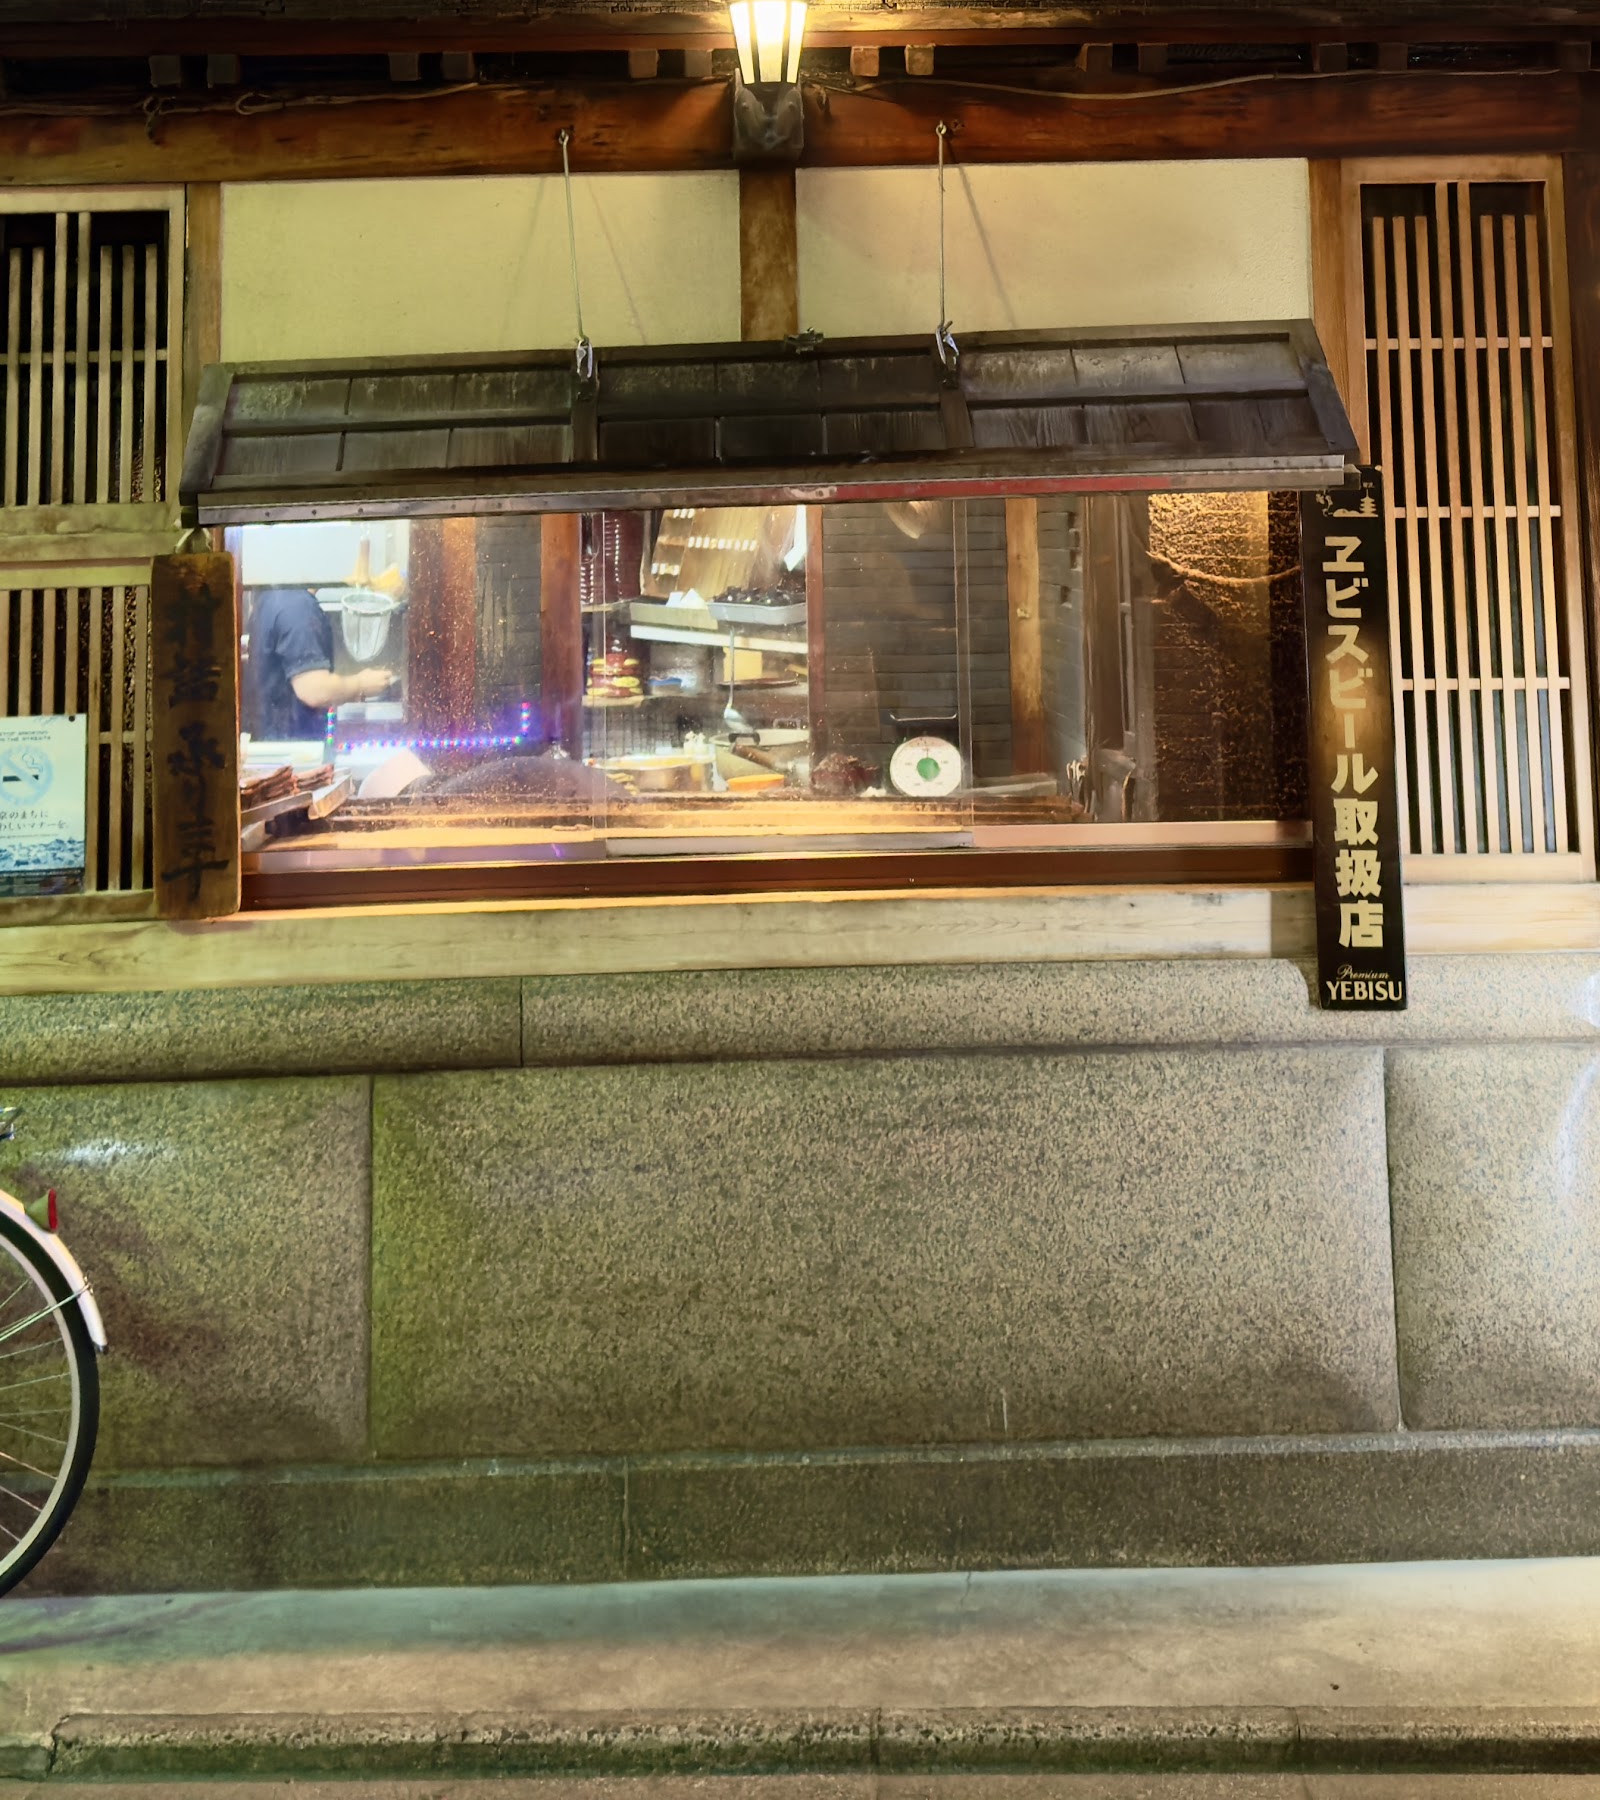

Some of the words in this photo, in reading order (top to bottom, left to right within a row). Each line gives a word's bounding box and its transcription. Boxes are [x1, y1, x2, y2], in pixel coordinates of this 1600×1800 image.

[1322, 536, 1384, 949] ヱビスビール取扱店
[1336, 964, 1389, 980] Premium
[1325, 980, 1403, 1001] YEBISU
